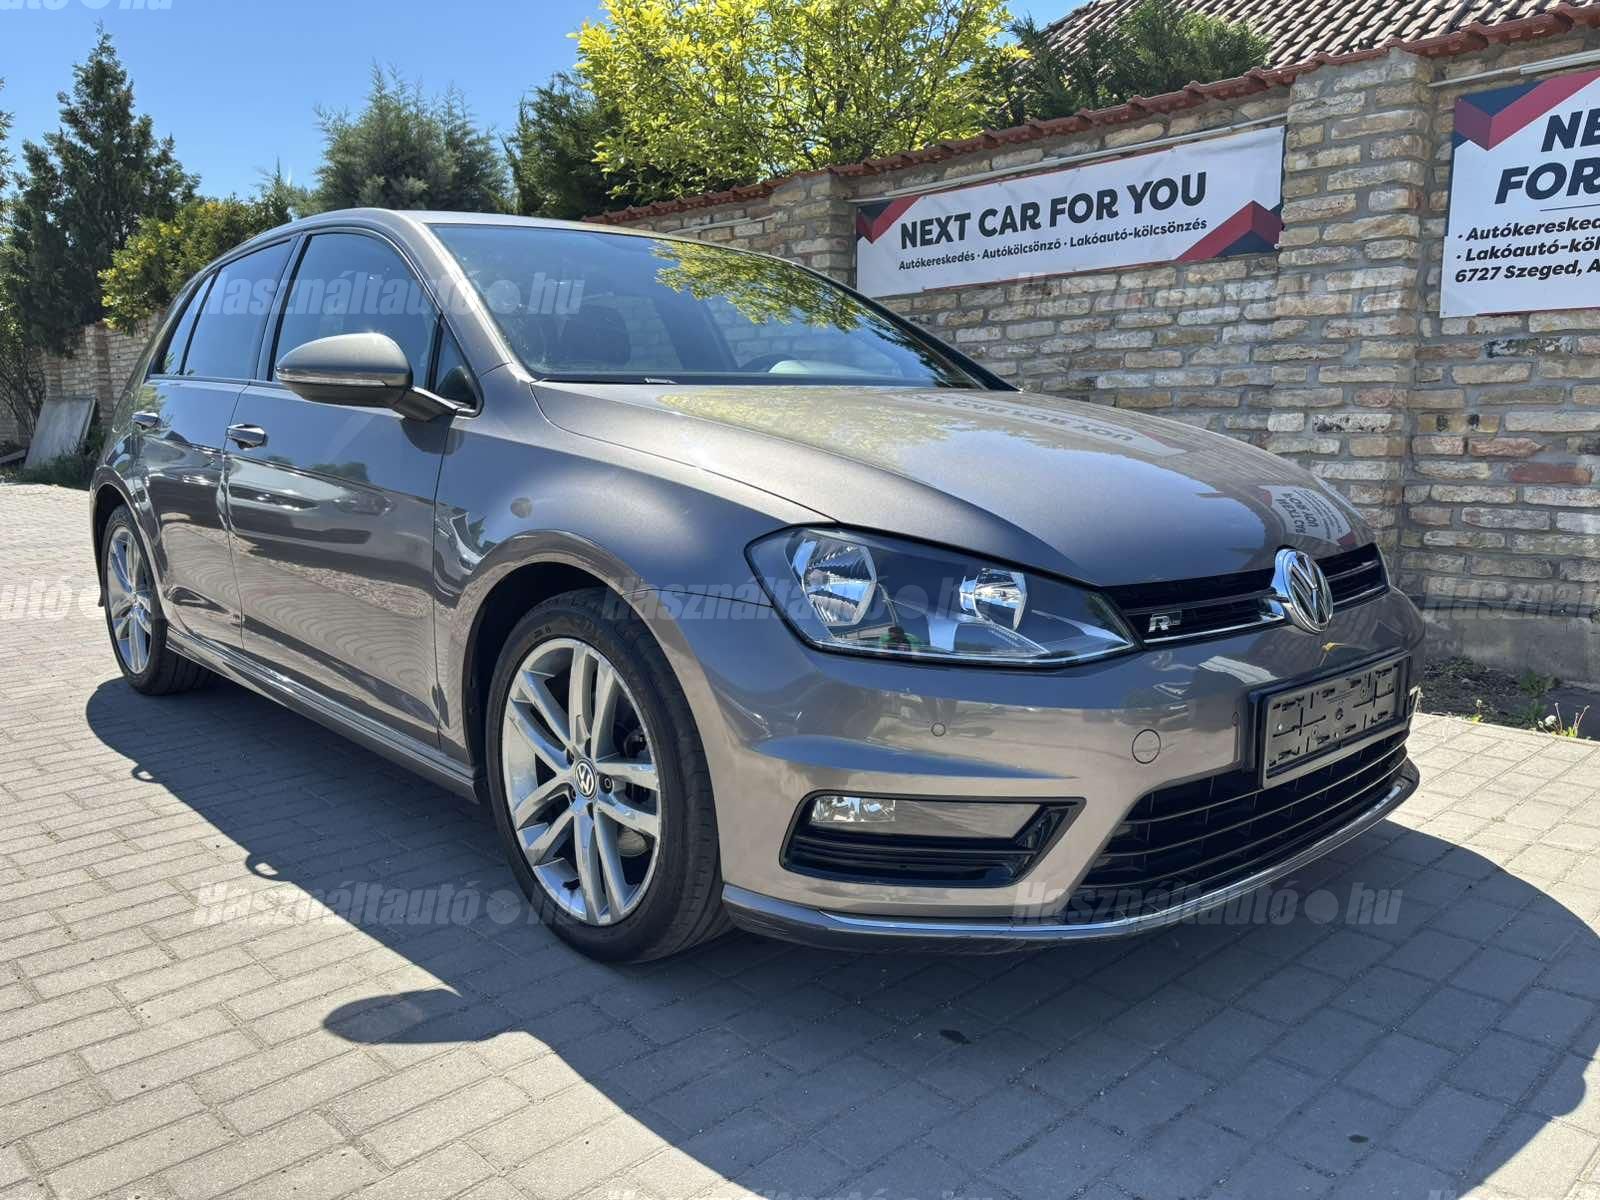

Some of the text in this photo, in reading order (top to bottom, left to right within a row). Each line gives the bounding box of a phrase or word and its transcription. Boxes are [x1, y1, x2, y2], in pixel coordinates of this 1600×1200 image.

[1541, 108, 1600, 152] NE
[1495, 157, 1600, 205] FOR
[901, 172, 1206, 249] NEXT CAR FOR YOU
[899, 251, 975, 271] Autókereskedés
[1070, 218, 1207, 248] Lakóautó-kölcsönzés
[1455, 267, 1502, 282] 6727
[1504, 260, 1583, 281] Szeged,
[1148, 614, 1171, 632] R
